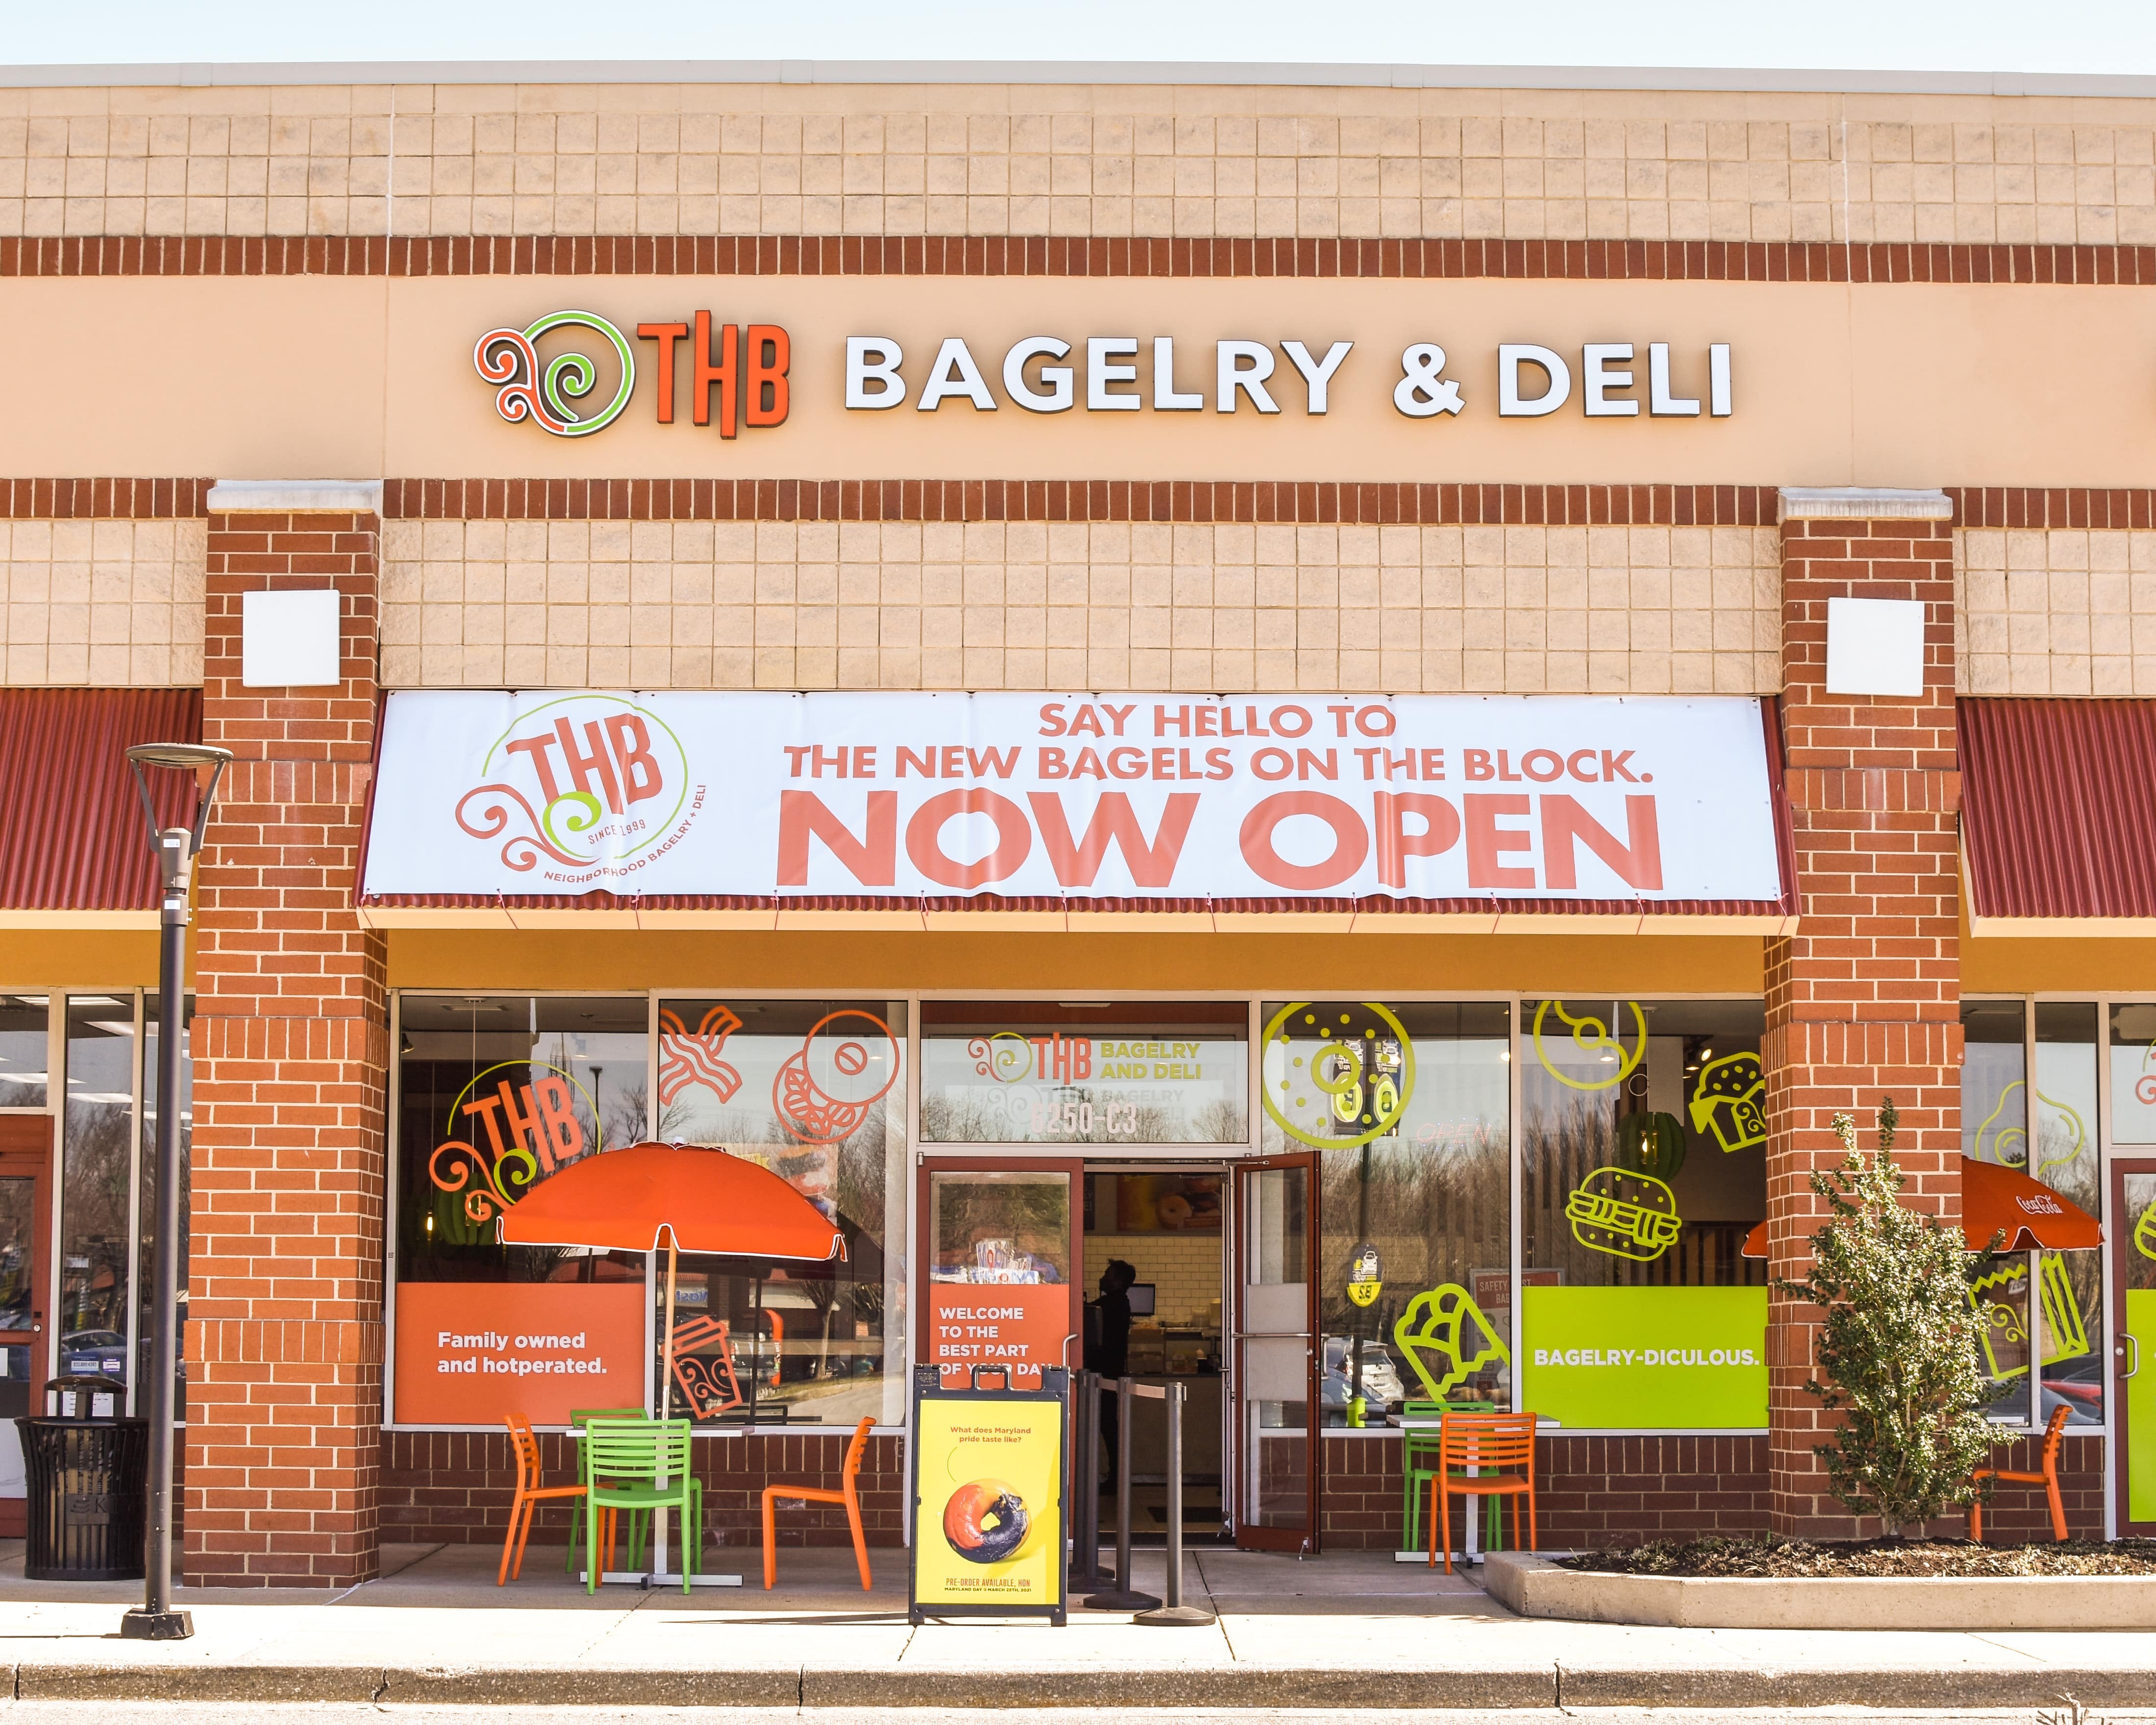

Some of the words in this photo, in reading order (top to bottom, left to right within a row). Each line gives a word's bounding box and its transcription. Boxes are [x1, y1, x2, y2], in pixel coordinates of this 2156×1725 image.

[637, 310, 791, 440] THB
[845, 336, 1355, 416] BAGELRY
[1393, 342, 1467, 419] &
[1497, 342, 1732, 418] DELI
[1038, 703, 1138, 738] SAY
[1153, 705, 1313, 739] HELLO
[1327, 705, 1396, 738] TO
[506, 713, 663, 815] THB
[784, 744, 877, 779] THE
[895, 745, 1022, 779] NEW
[1038, 746, 1234, 781] BAGELS
[1250, 747, 1338, 781] ON
[1353, 747, 1446, 782] THE
[1464, 749, 1654, 783] BLOCK.
[544, 859, 646, 884] NEIGHBORHOOD
[647, 819, 693, 862] BAGELRY
[692, 785, 707, 810] DELI
[588, 825, 617, 845] SINCE
[620, 819, 647, 836] 1999
[776, 787, 1201, 890] NOW
[1239, 790, 1664, 890] OPEN
[1029, 1032, 1092, 1085] THB
[1101, 1042, 1201, 1059] BAGELRY
[1100, 1063, 1148, 1080] AND
[1153, 1063, 1201, 1080] DELI
[462, 1076, 583, 1173] THB
[1030, 1102, 1137, 1134] 6250-C3
[1416, 1123, 1492, 1145] OPEN
[1480, 1280, 1507, 1292] SAFETY
[939, 1307, 1024, 1320] WELCOME
[438, 1331, 509, 1352] Family
[514, 1332, 586, 1349] owned
[939, 1326, 962, 1338] TO
[966, 1326, 998, 1338] THE
[939, 1344, 980, 1356] BEST
[985, 1344, 1029, 1356] PART
[1534, 1349, 1760, 1366] BAGELRY-DICULOUS.
[437, 1356, 477, 1373] and
[483, 1356, 608, 1377] hotperated.
[941, 1363, 962, 1375] OF
[1017, 1363, 1053, 1375] DA
[946, 1578, 980, 1586] PRE-ORDER
[981, 1578, 1016, 1588] AVAILABLE,
